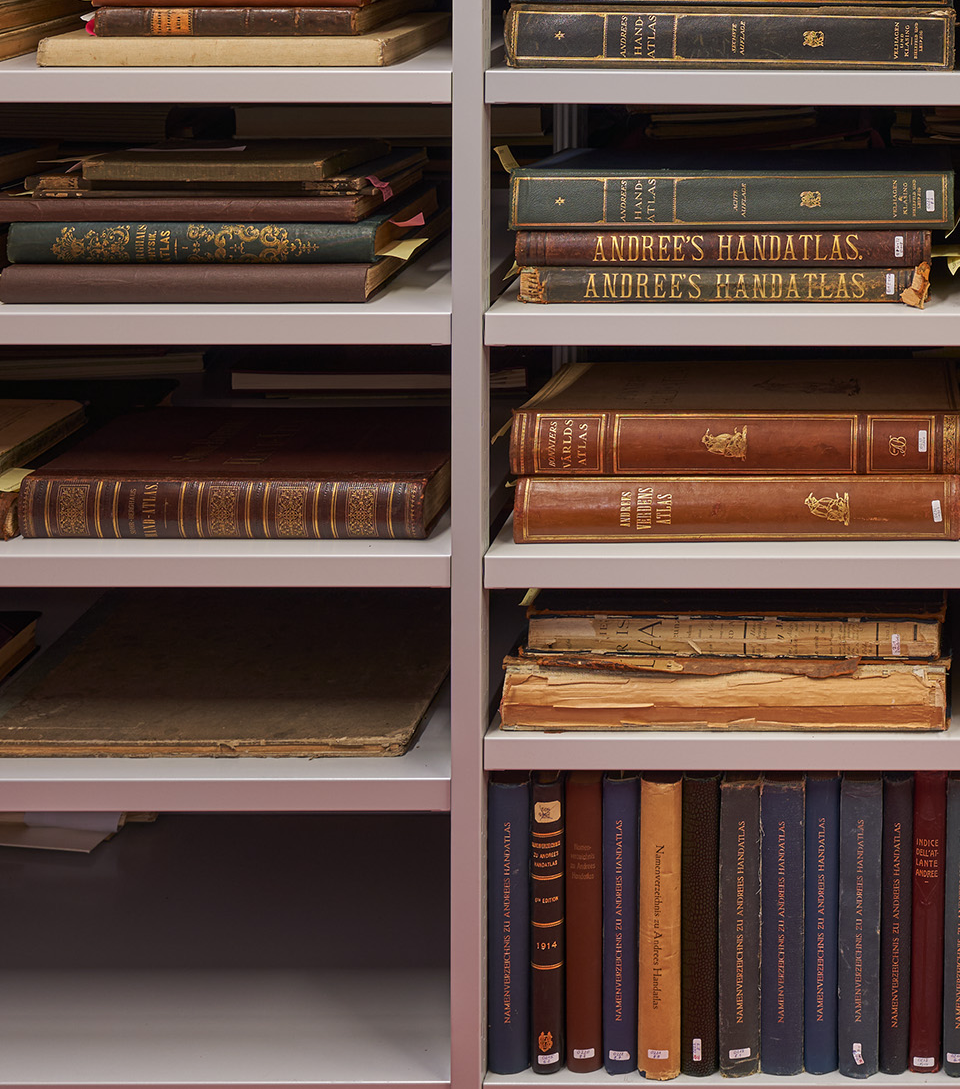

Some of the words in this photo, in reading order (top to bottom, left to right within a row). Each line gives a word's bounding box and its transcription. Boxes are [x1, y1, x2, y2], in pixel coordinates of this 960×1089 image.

[620, 16, 628, 57] ANDREES
[647, 15, 657, 58] ATLAS
[620, 180, 628, 222] ANDREES
[647, 179, 657, 223] ATLAS
[593, 235, 704, 261] ANDREE'S
[717, 234, 863, 261] HANDATLAS.
[584, 273, 702, 299] ANDREE'S
[715, 273, 865, 299] HANDATLAS
[577, 423, 588, 466] ATLAS
[637, 488, 653, 530] VERDENS
[656, 494, 672, 525] ATLAS
[818, 818, 826, 871] HANDATLAS
[916, 838, 939, 846] INDICE
[916, 859, 938, 868] LANTE
[916, 869, 938, 878] ANDREE
[654, 845, 665, 916] Namenverzeichnis
[737, 875, 745, 917] ANDREES
[504, 920, 511, 932] ZU
[616, 919, 622, 930] ZU
[654, 917, 660, 929] zu
[737, 919, 744, 931] ZU
[818, 918, 825, 929] ZU
[856, 919, 863, 931] ZU
[536, 941, 557, 950] 1914
[653, 931, 662, 965] Andrees
[652, 968, 662, 1010] Handatlas
[736, 934, 744, 1023] NAMENVERZEICHNIS
[855, 933, 863, 1023] NAMENVERZEICHNIS
